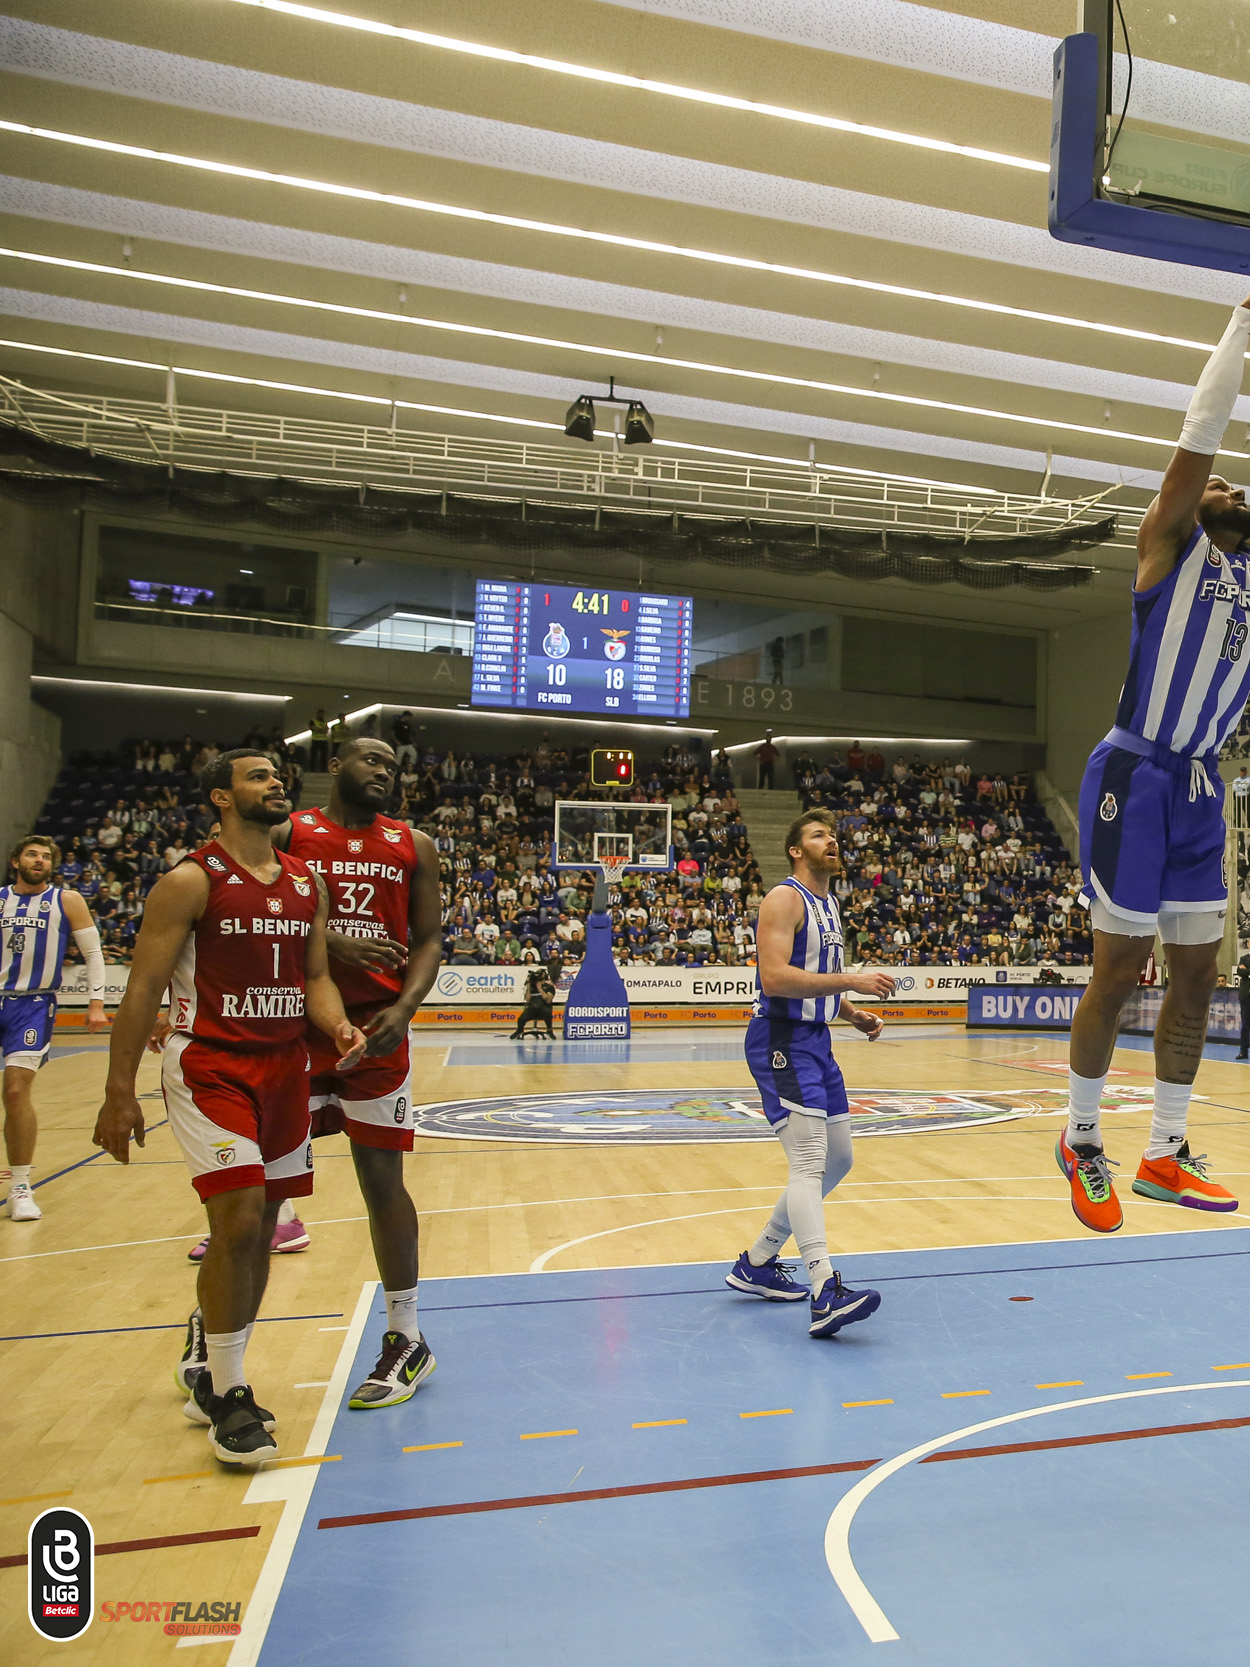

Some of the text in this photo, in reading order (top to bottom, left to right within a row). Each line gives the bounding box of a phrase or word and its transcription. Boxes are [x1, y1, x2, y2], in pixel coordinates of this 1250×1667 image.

[544, 593, 550, 606] 1
[572, 591, 609, 615] 4:41
[621, 599, 629, 612] 0
[582, 636, 588, 649] 1
[1219, 617, 1249, 662] 13
[547, 664, 566, 686] 10
[605, 668, 624, 689] 18
[538, 692, 571, 704] FC PORTO
[605, 696, 619, 707] SLB
[726, 684, 793, 711] 1893
[305, 860, 404, 884] SL BENFICA
[337, 882, 375, 916] 32
[220, 918, 247, 935] SL
[328, 918, 384, 930] conservas
[7, 932, 26, 953] 43
[272, 943, 280, 979] 1
[466, 974, 515, 987] earth
[626, 980, 682, 988] OMATAPALO
[246, 986, 301, 995] conserva
[466, 985, 514, 993] consulters
[221, 993, 305, 1018] RAMIRE
[568, 1006, 628, 1018] BORDISPORT
[982, 996, 1030, 1018] BUY
[437, 1013, 463, 1021] Porto
[490, 1012, 516, 1021] Porto
[568, 1022, 627, 1038] FCPORTO
